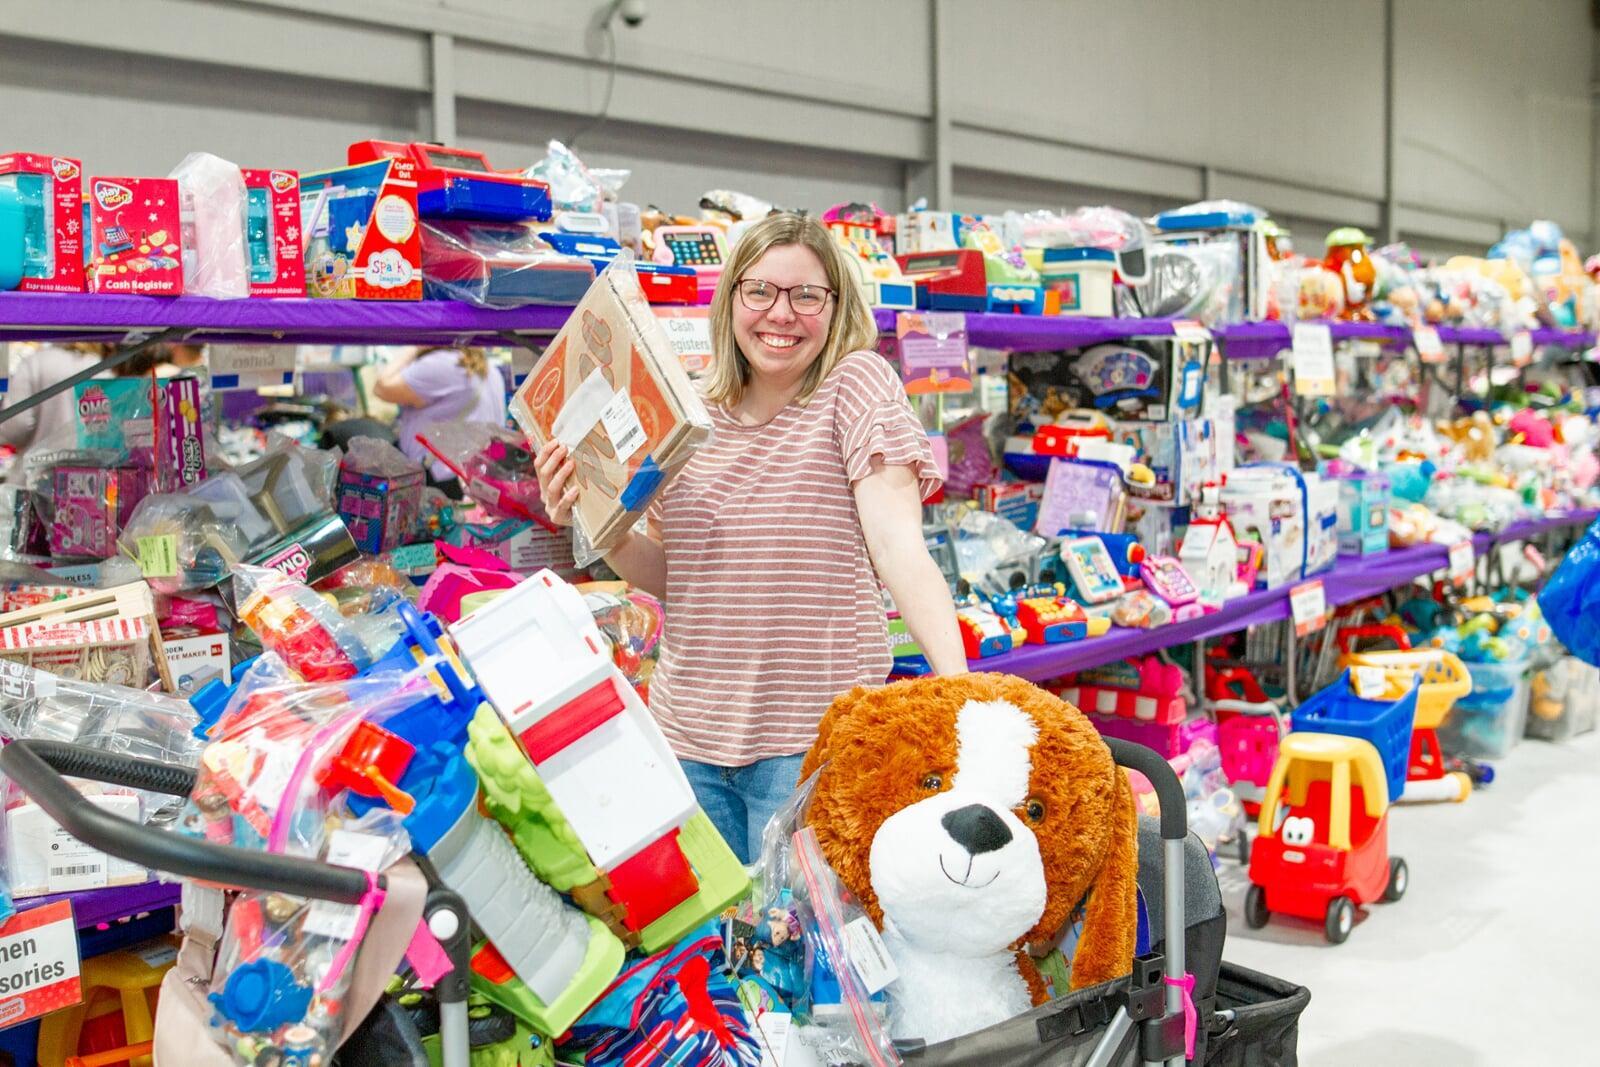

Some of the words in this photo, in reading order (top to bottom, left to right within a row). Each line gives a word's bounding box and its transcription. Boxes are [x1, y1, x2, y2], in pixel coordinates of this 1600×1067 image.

[25, 282, 54, 292] Espresso
[54, 284, 81, 292] Machine
[105, 280, 130, 290] Cash
[131, 280, 174, 292] Register
[669, 319, 695, 332] Cash
[670, 338, 710, 355] egisters
[79, 401, 111, 417] OMG
[182, 650, 207, 659] MAKER
